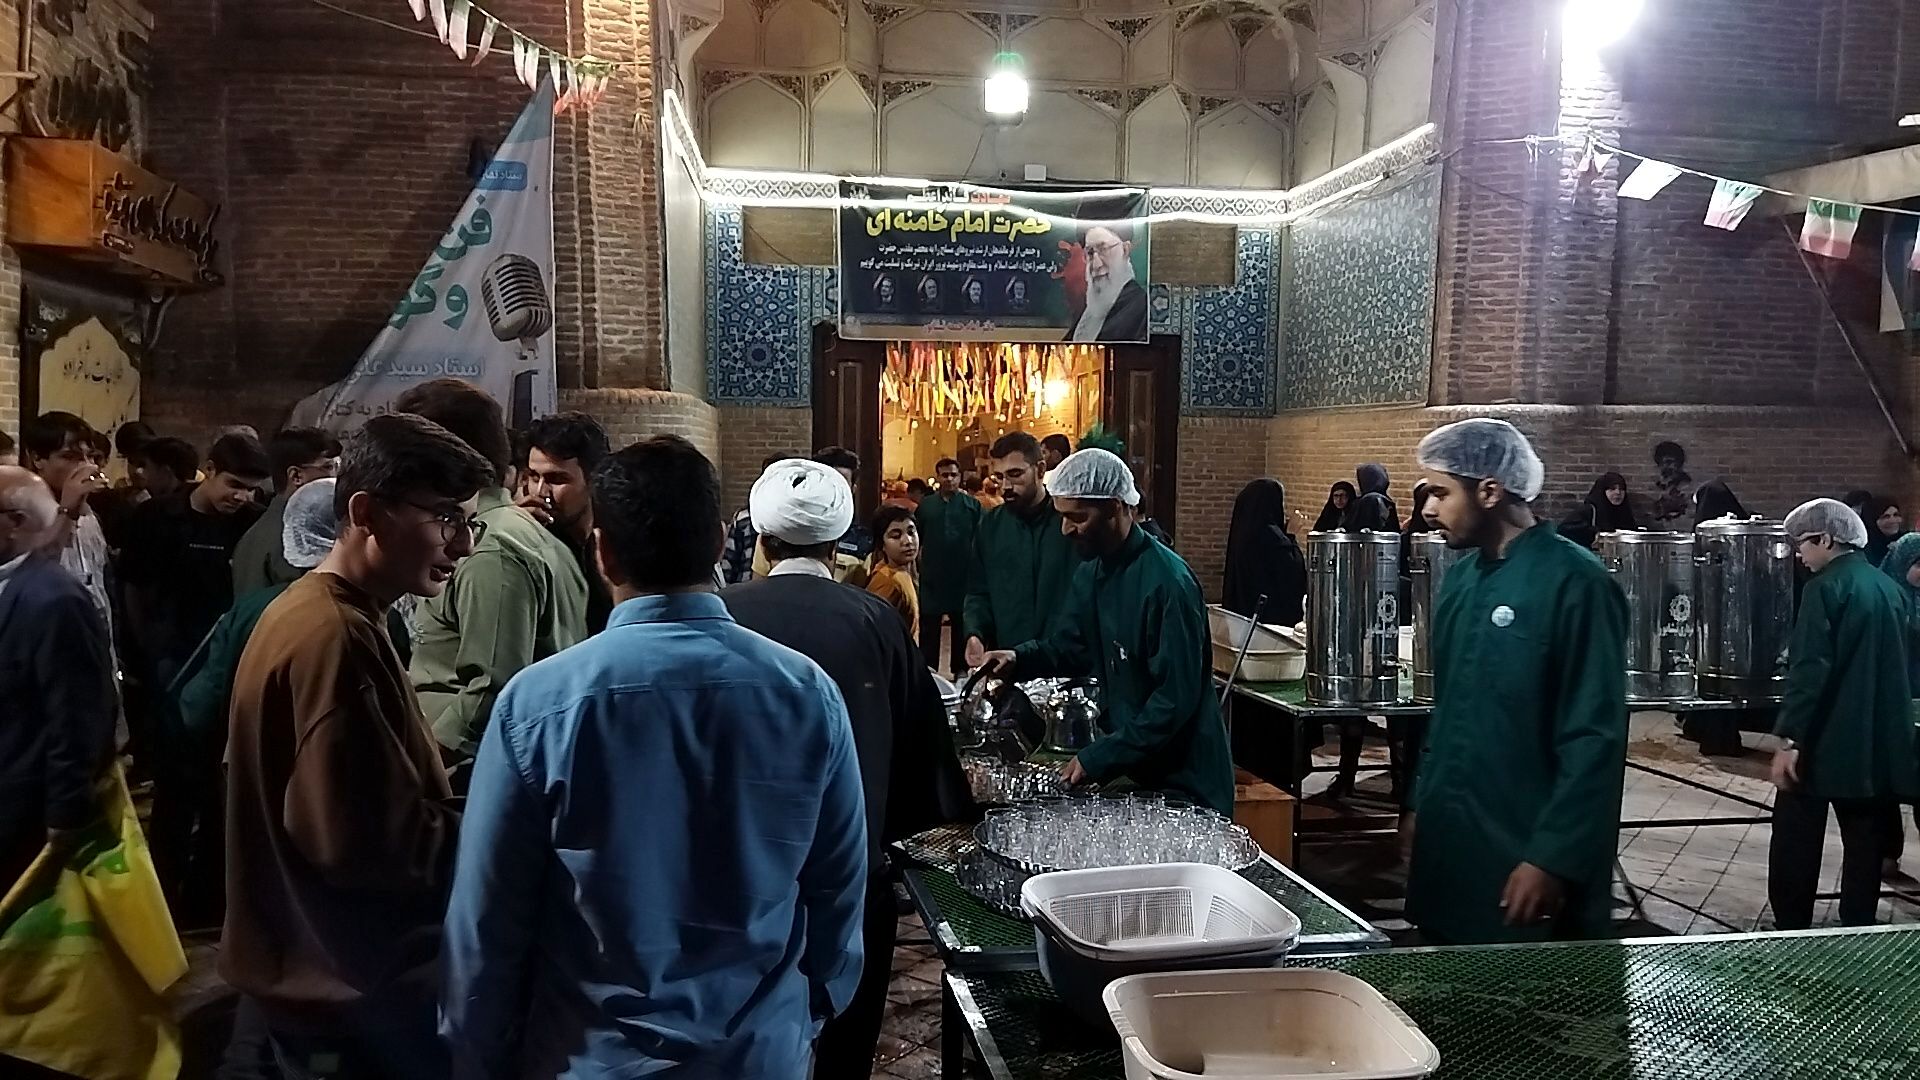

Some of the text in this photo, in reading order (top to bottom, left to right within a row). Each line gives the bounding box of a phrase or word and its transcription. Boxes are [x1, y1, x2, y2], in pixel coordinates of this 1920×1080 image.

[865, 203, 1052, 242] حضرت امام خامنه ای
[386, 358, 430, 381] سید
[432, 355, 486, 379] استاد
